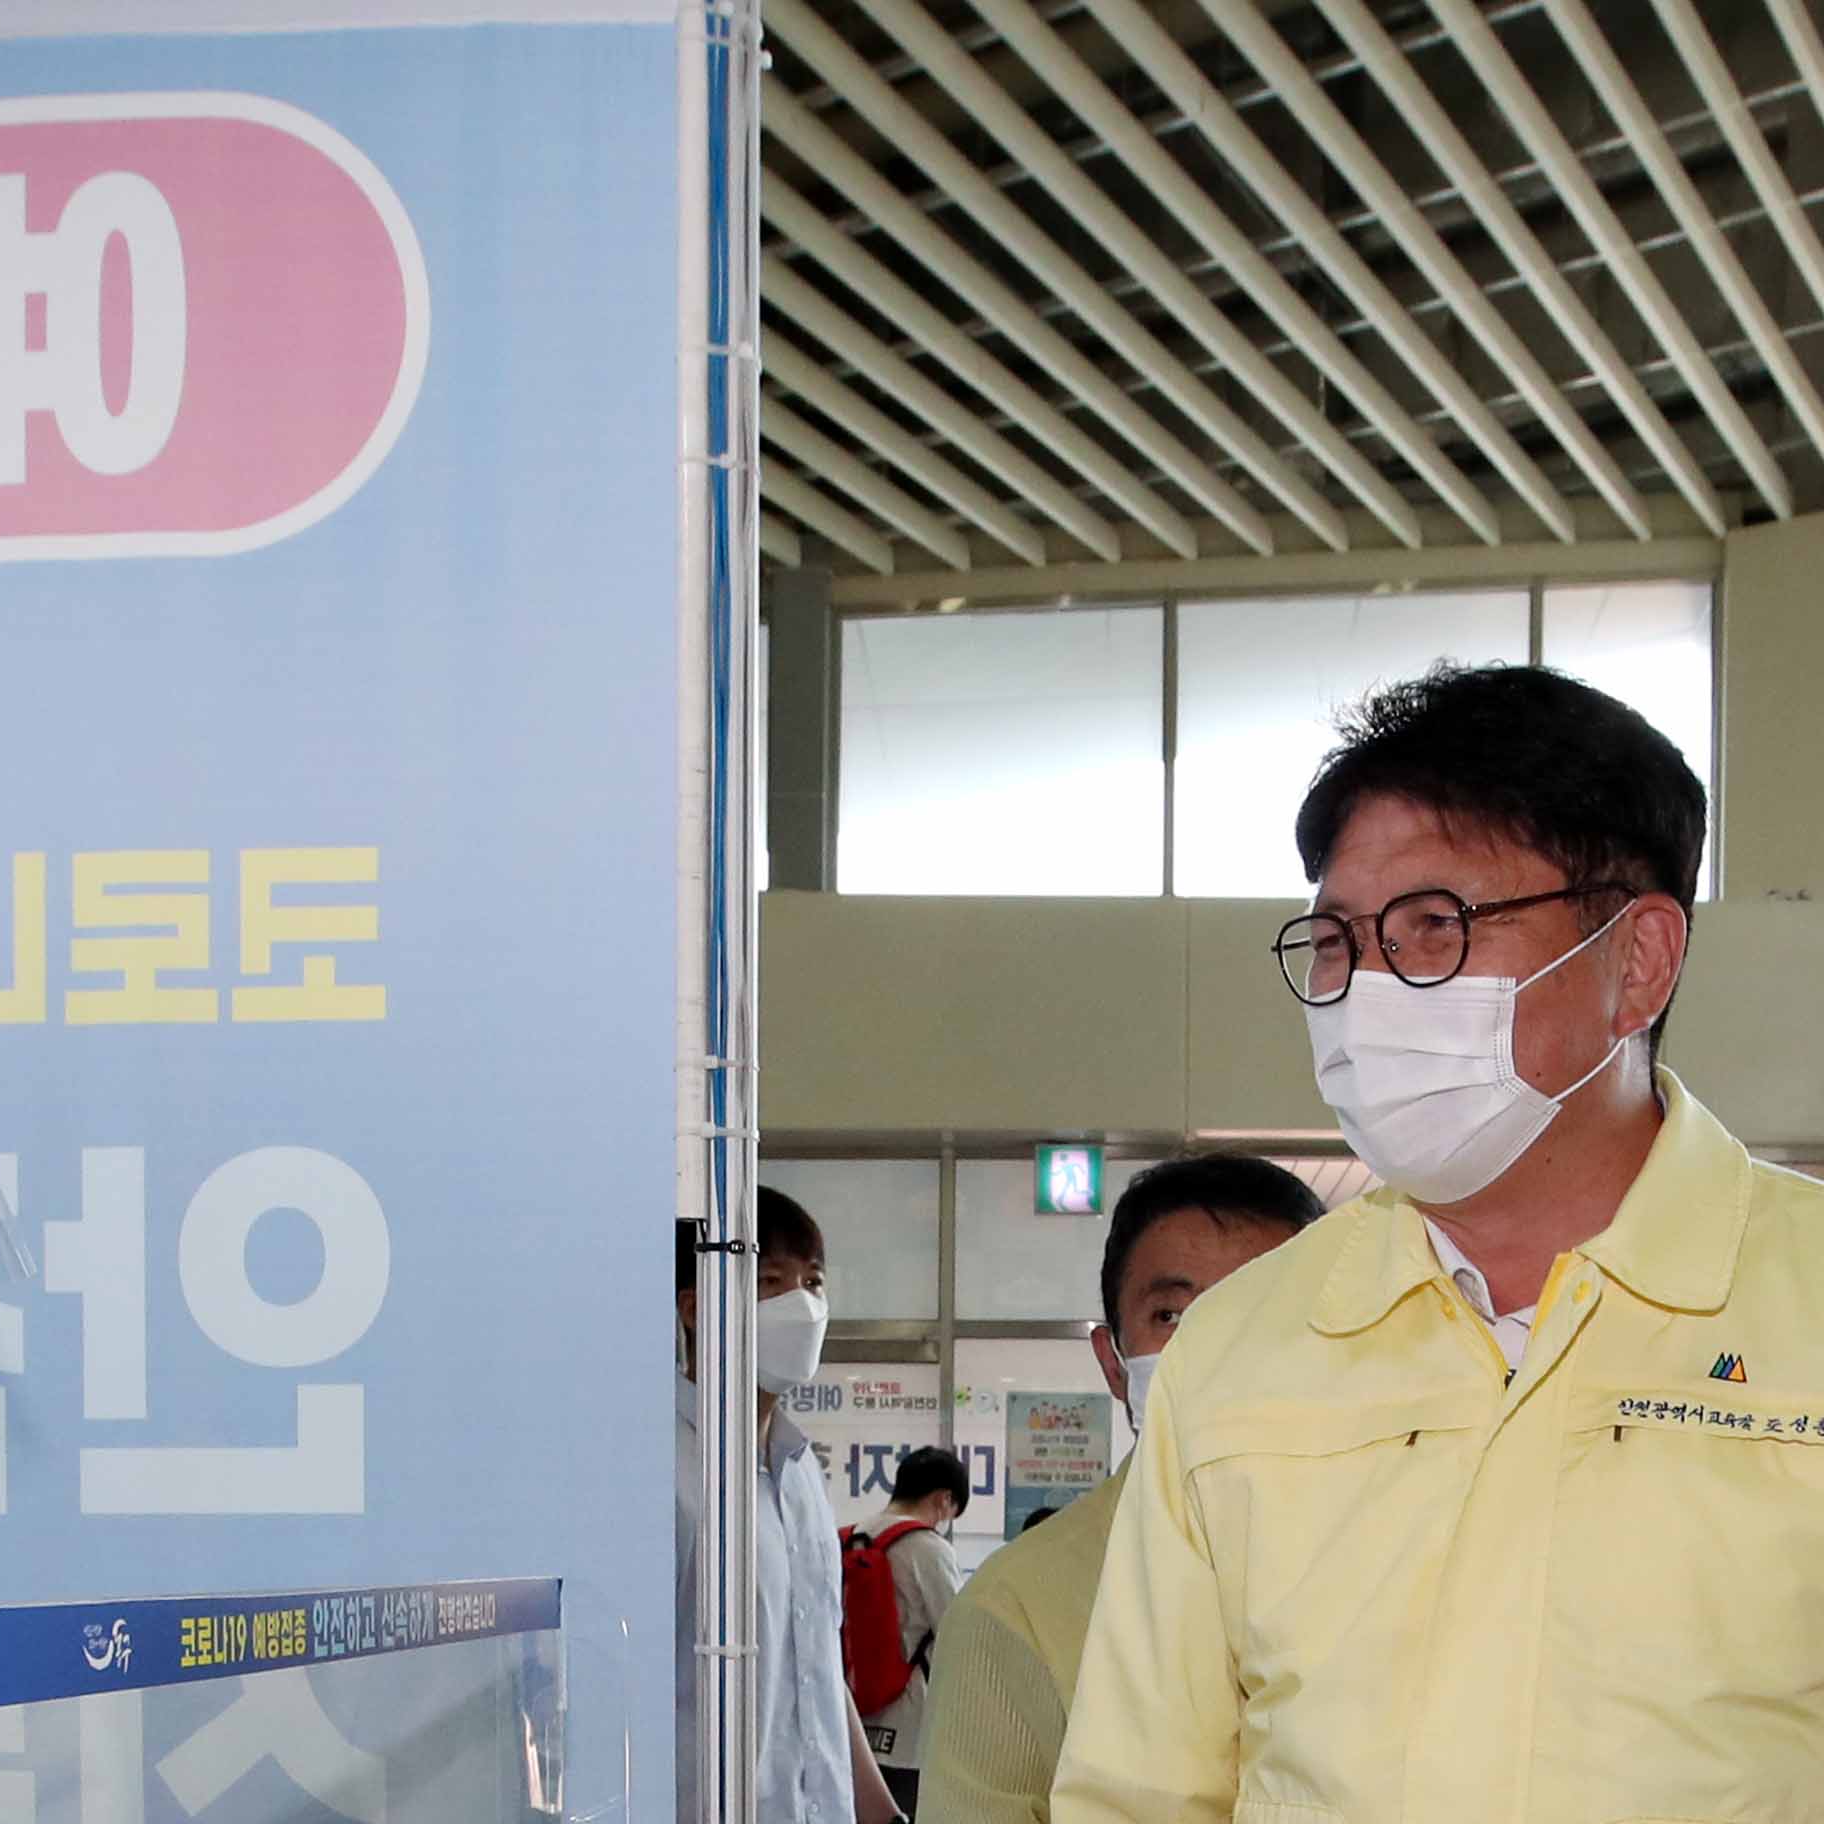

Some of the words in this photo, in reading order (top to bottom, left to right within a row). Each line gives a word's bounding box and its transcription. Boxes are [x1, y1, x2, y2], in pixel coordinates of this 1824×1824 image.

[181, 1613, 248, 1669] 코로나19
[252, 1607, 307, 1660] 예방접종
[312, 1596, 378, 1658] 안전하고
[381, 1590, 435, 1649] 신속하게
[437, 1591, 497, 1636] 진행하겠습니다
